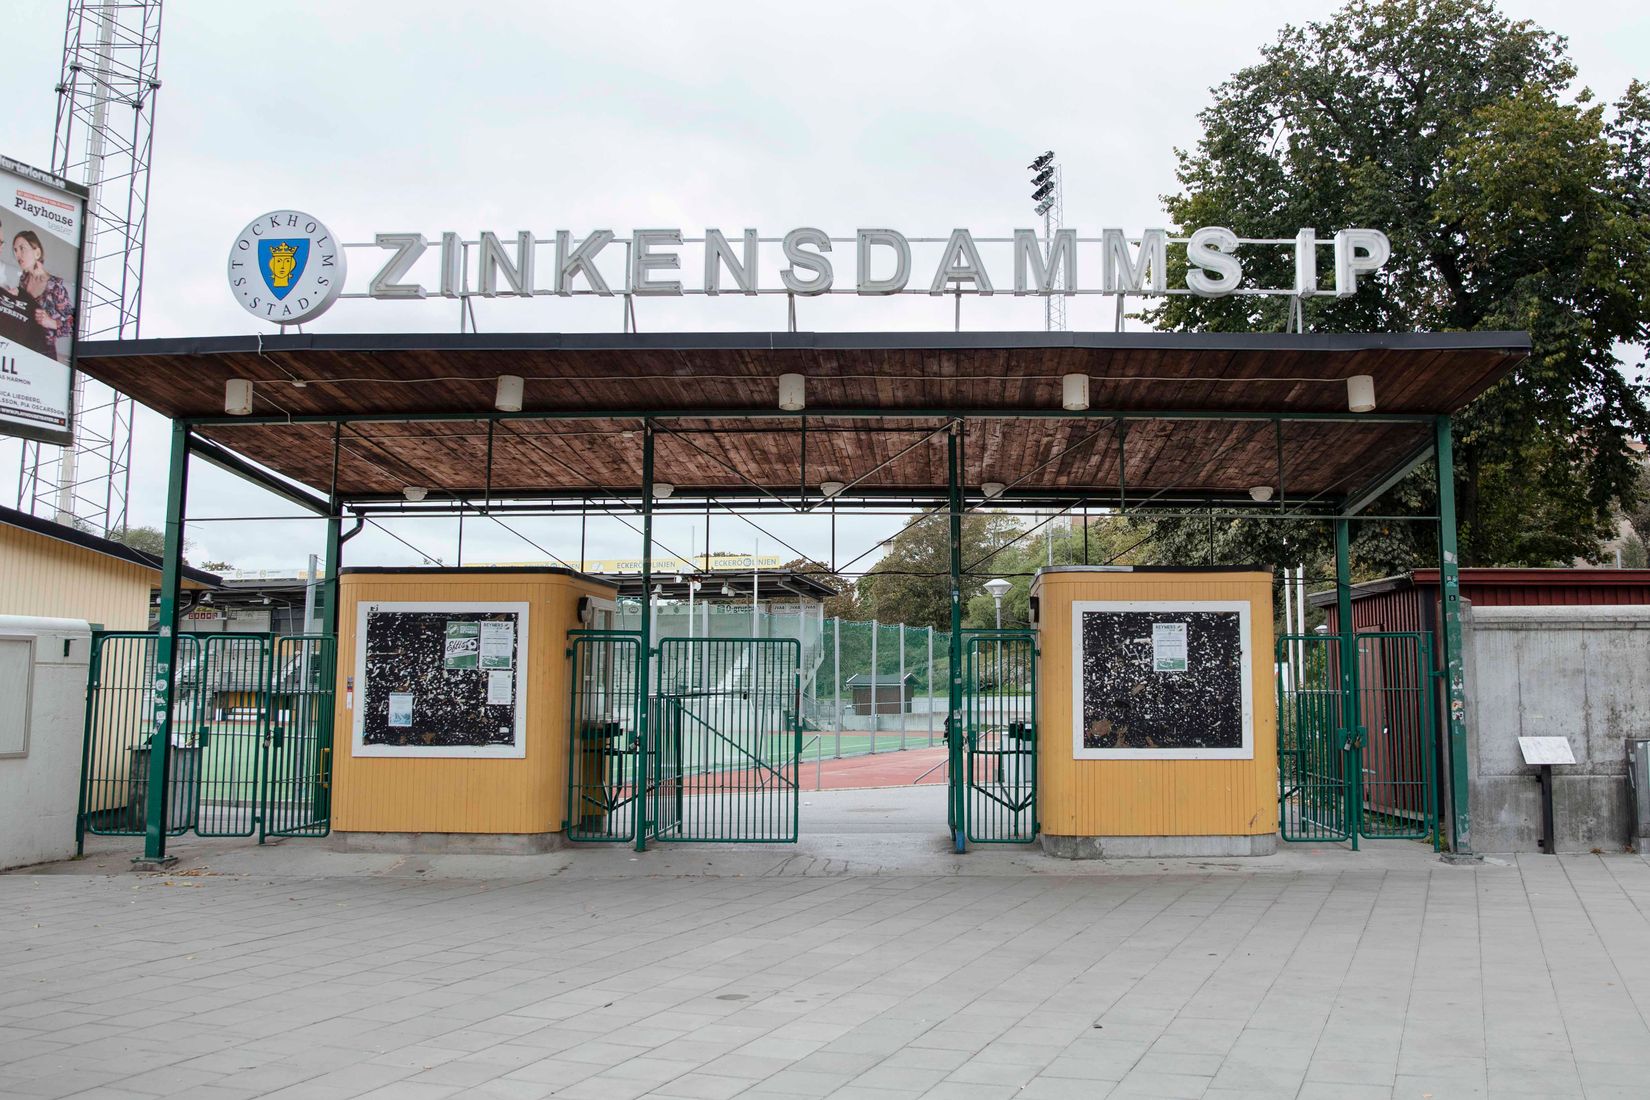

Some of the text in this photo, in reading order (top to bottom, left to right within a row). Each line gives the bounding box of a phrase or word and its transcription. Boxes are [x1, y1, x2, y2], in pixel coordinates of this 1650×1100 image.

[15, 197, 73, 226] Playhouse
[232, 214, 334, 287] STOCKHOLMS
[369, 226, 1390, 298] ZINKENSDAMMS IP
[249, 296, 310, 316] STAD
